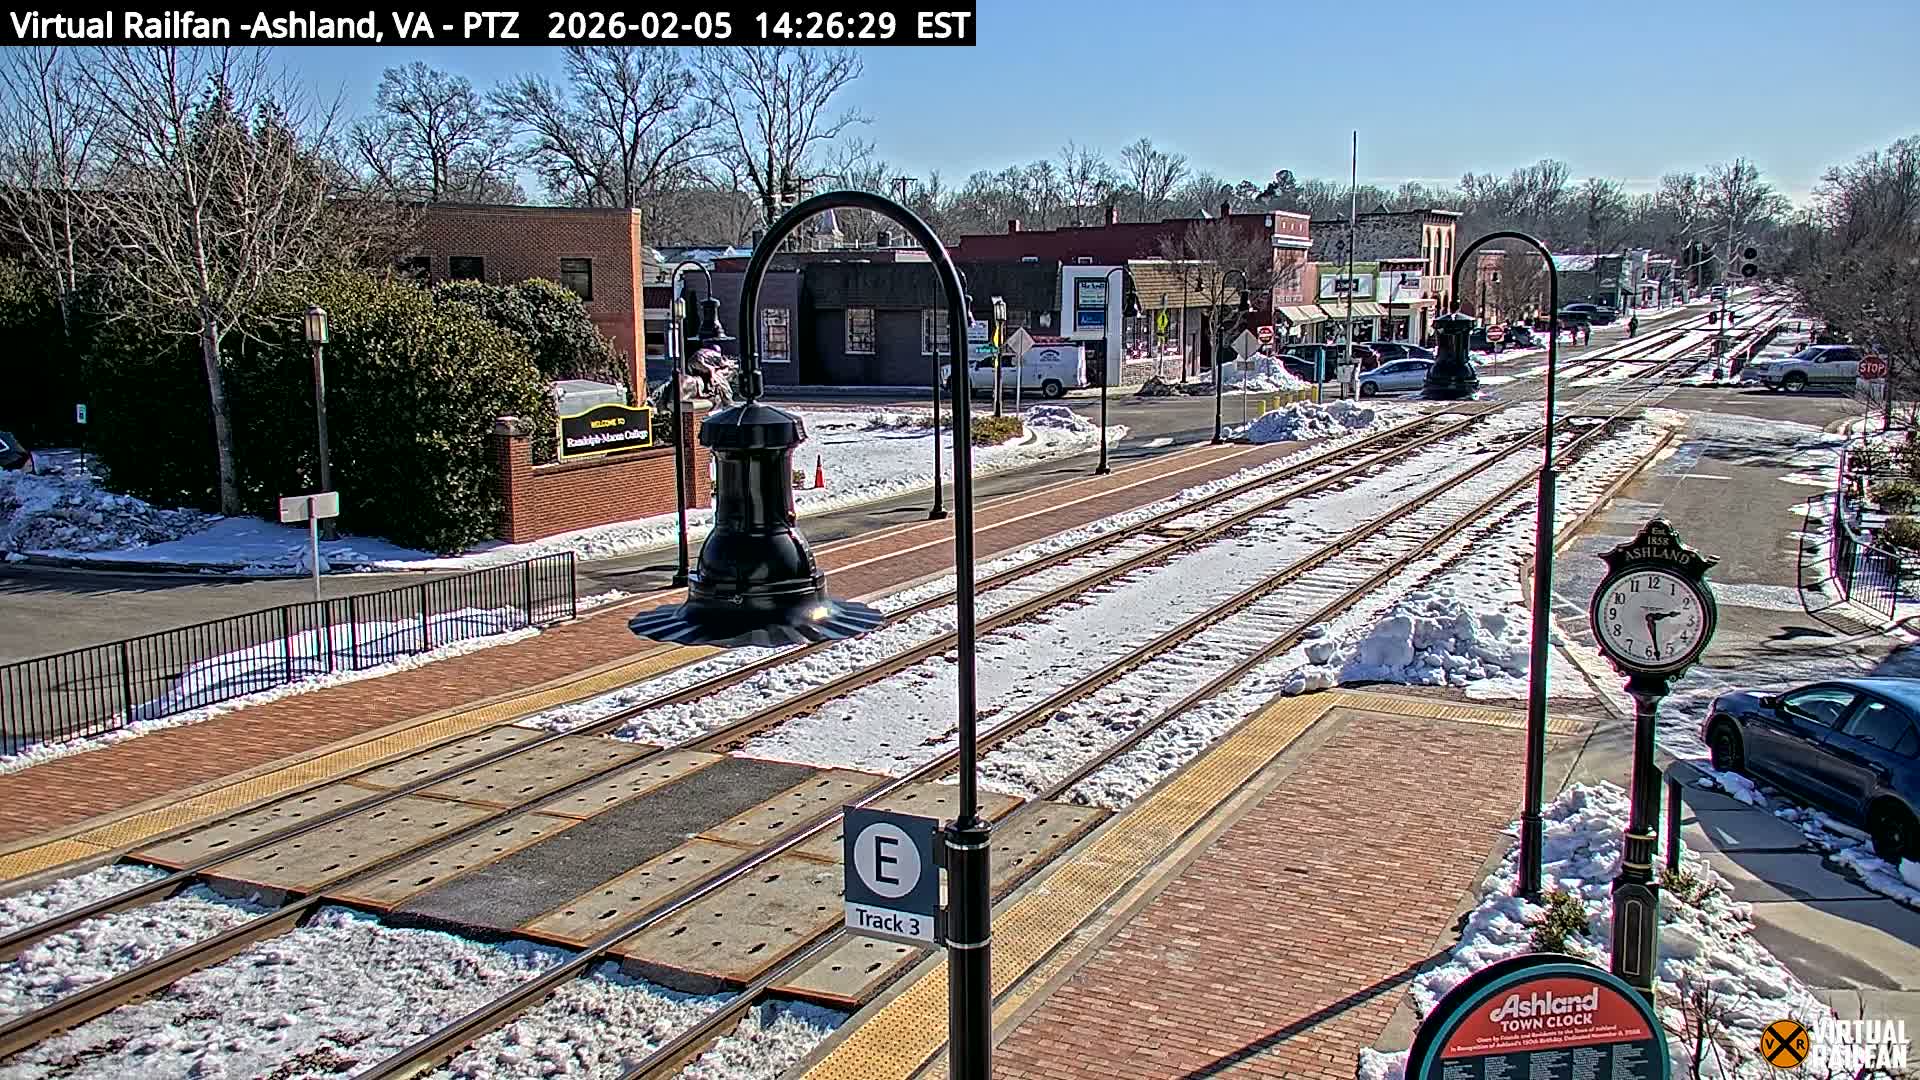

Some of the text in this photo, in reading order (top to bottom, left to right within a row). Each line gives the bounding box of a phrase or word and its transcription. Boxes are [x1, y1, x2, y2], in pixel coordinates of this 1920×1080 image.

[1860, 362, 1885, 374] STOP
[1647, 536, 1669, 546] 1858
[1625, 547, 1690, 565] ASHLAND
[1630, 580, 1640, 593] 11
[1648, 577, 1660, 590] 12
[1670, 584, 1676, 596] 1
[1614, 593, 1626, 604] 10
[1682, 598, 1690, 610] 2
[1609, 608, 1617, 620] 9
[1687, 616, 1695, 627] 3
[1613, 624, 1622, 637] 8
[1680, 630, 1688, 642] 4
[1626, 639, 1634, 652] 7
[1645, 645, 1653, 657] 6
[1665, 642, 1674, 655] 5
[875, 835, 899, 886] E
[855, 907, 920, 936] Track 3
[1489, 986, 1599, 1022] Ashland
[1501, 1012, 1593, 1032] TOWN CLOCK
